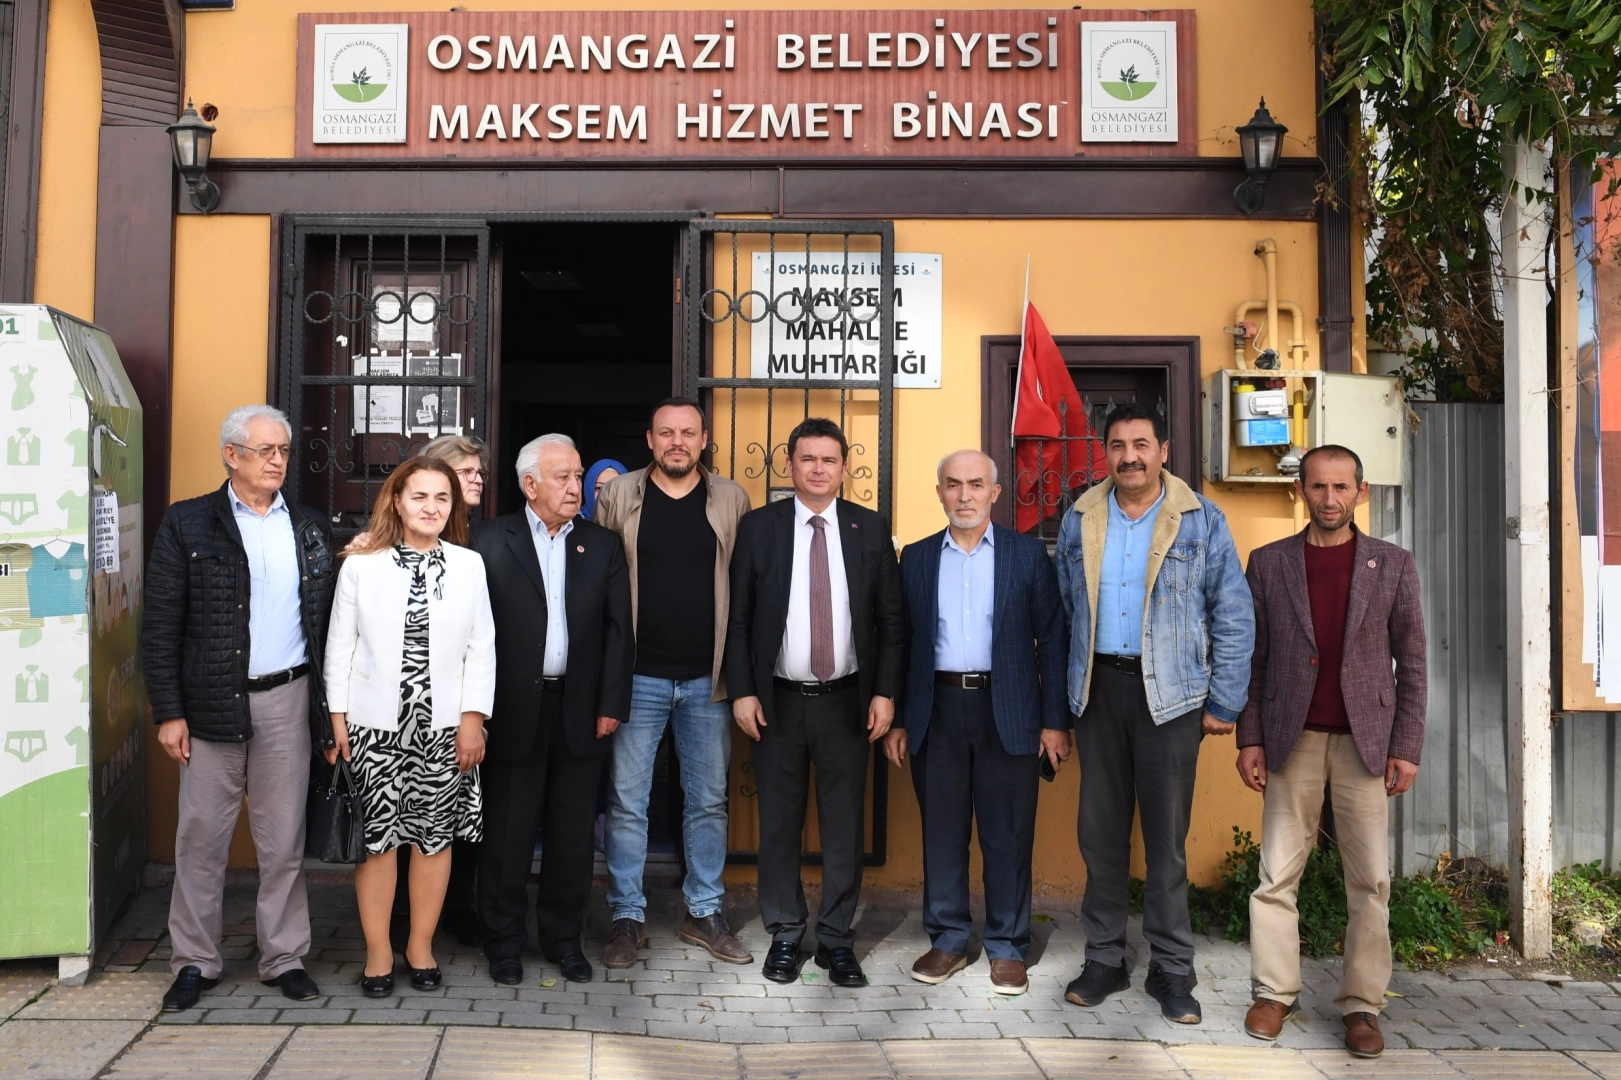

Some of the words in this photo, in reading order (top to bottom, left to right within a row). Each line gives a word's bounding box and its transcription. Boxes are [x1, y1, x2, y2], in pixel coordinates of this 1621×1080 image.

[333, 40, 365, 61] OSMANGAZİ
[427, 19, 735, 71] OSMANGAZİ
[776, 17, 1059, 69] BELEDİYESİ
[1100, 38, 1132, 59] OSMANGAZİ
[323, 113, 396, 124] OSMANGAZİ
[428, 103, 648, 141] MAKSEM
[677, 89, 863, 140] HİZMET
[893, 91, 1059, 139] BİNASI
[1091, 111, 1167, 122] OSMANGAZİ
[323, 125, 396, 135] BELEDİYESİ
[1092, 123, 1168, 133] BELEDİYESİ
[778, 262, 865, 275] OSMANGAZİ
[871, 261, 915, 275] İLESİ
[786, 321, 908, 340] MAHALE
[767, 350, 926, 375] MUHTARIĞI
